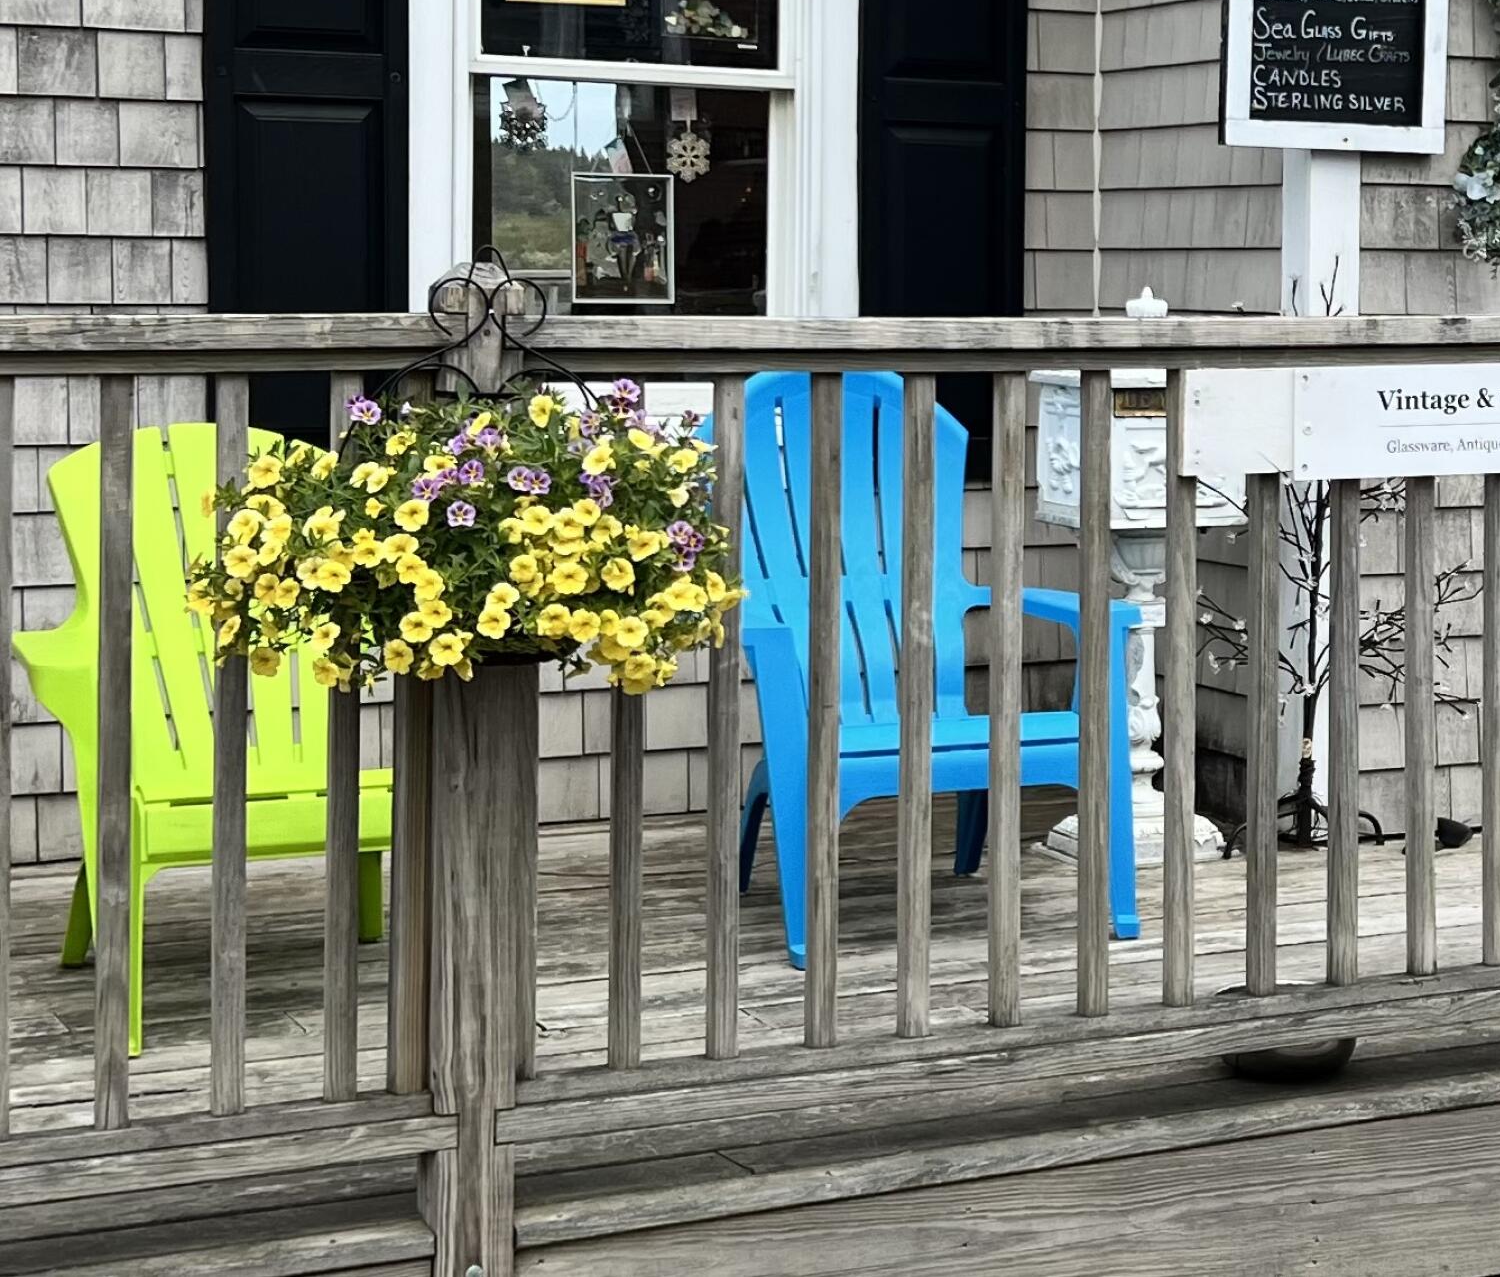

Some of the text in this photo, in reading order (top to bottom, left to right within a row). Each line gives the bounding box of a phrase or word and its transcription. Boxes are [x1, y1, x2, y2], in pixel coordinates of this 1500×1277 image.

[1254, 7, 1297, 39] Sea
[1253, 65, 1341, 88] CANDLES
[1252, 87, 1405, 112] STERLING SILVER
[1377, 389, 1470, 415] Vintage
[1476, 388, 1494, 408] &
[1386, 438, 1454, 454] Glassware,
